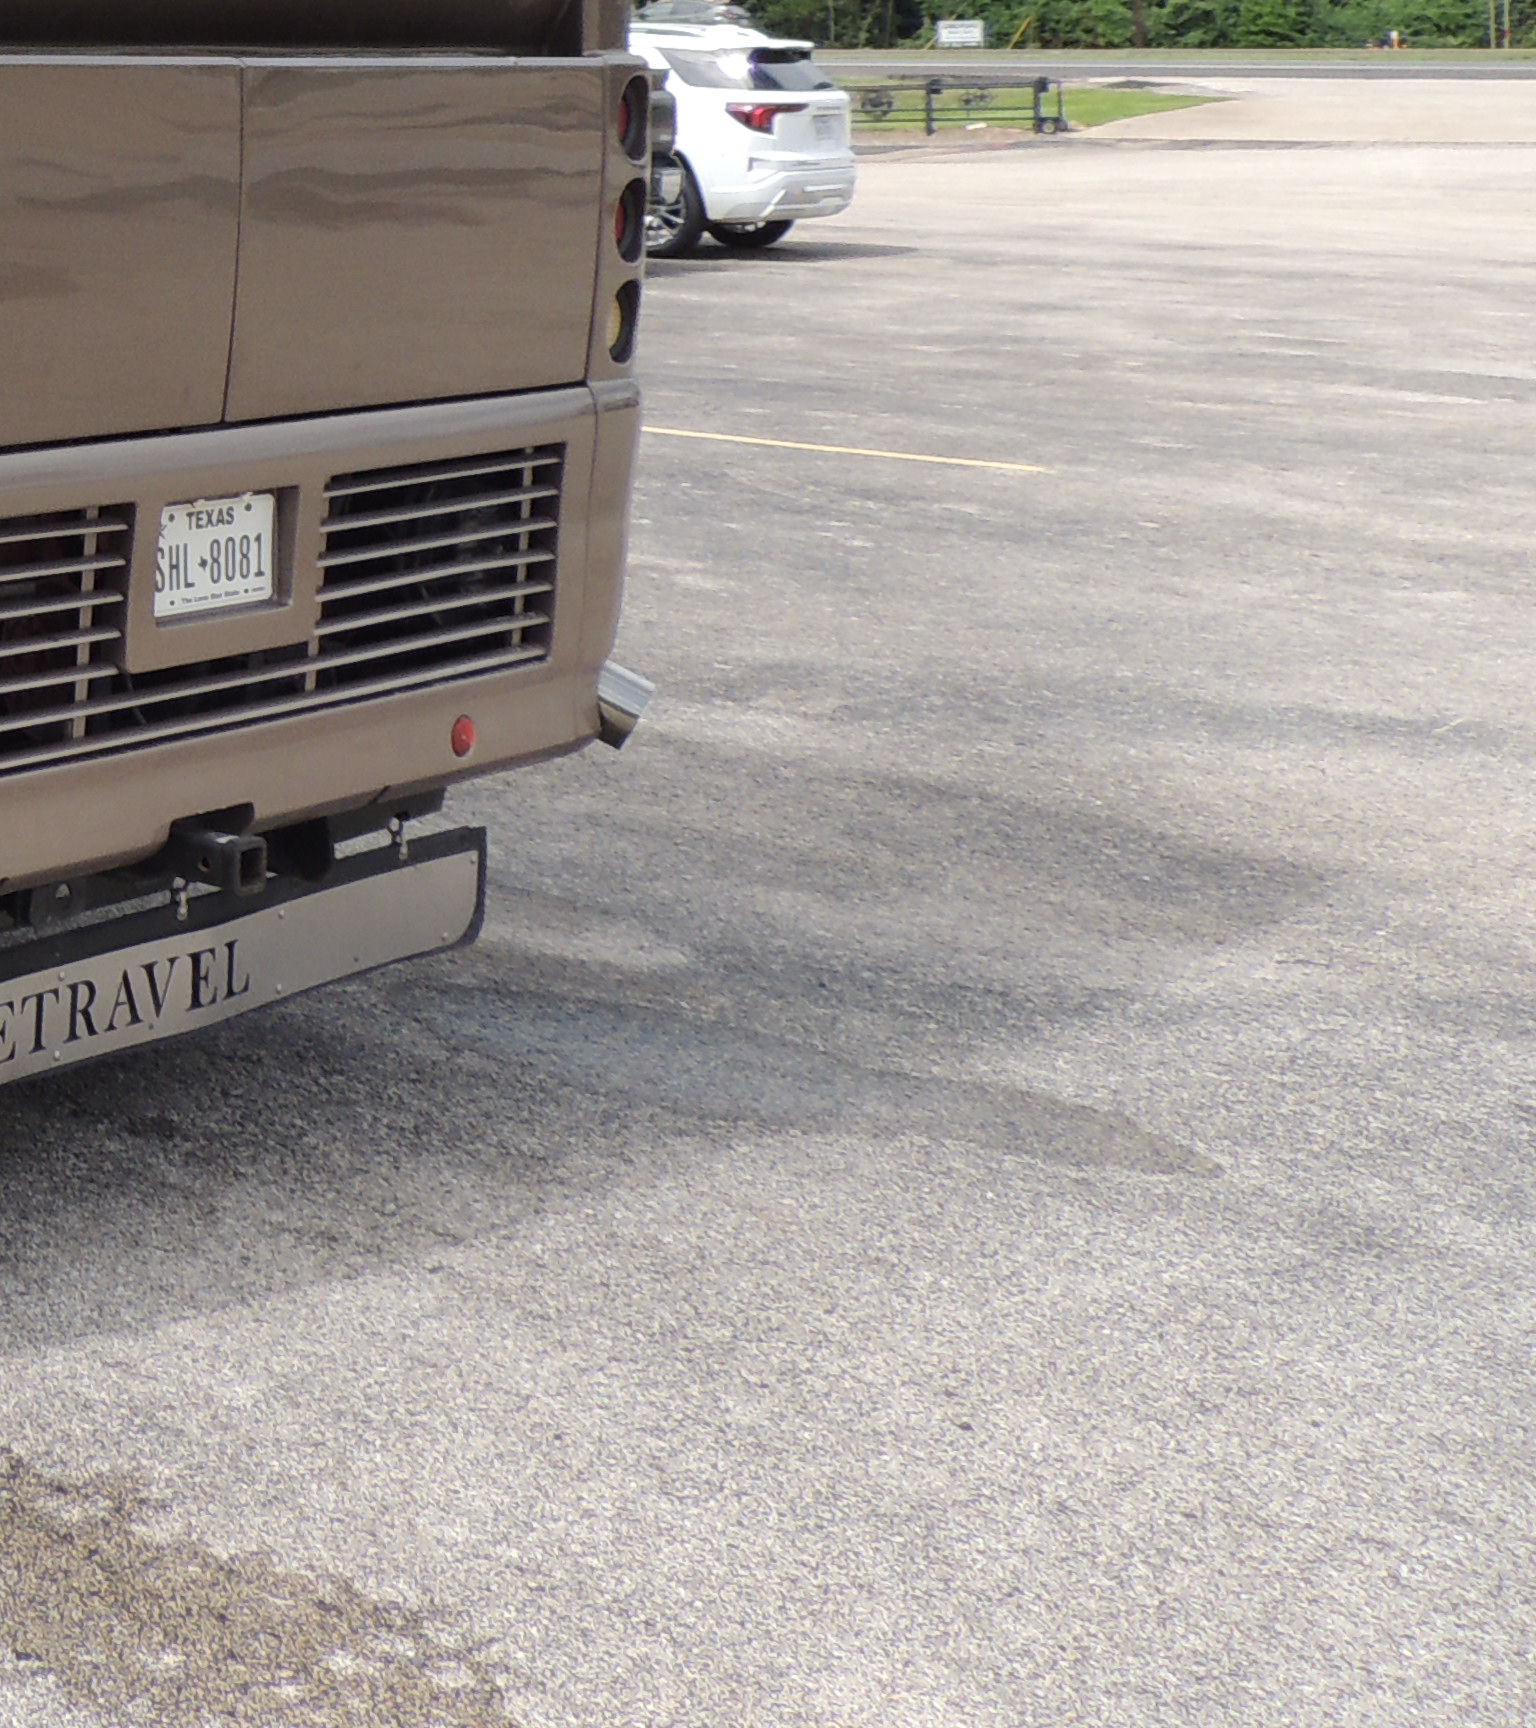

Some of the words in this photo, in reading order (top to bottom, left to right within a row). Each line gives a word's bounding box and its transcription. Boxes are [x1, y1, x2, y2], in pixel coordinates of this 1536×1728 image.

[185, 505, 235, 530] TEXAS
[155, 542, 196, 593] SHL
[210, 532, 266, 584] 8081
